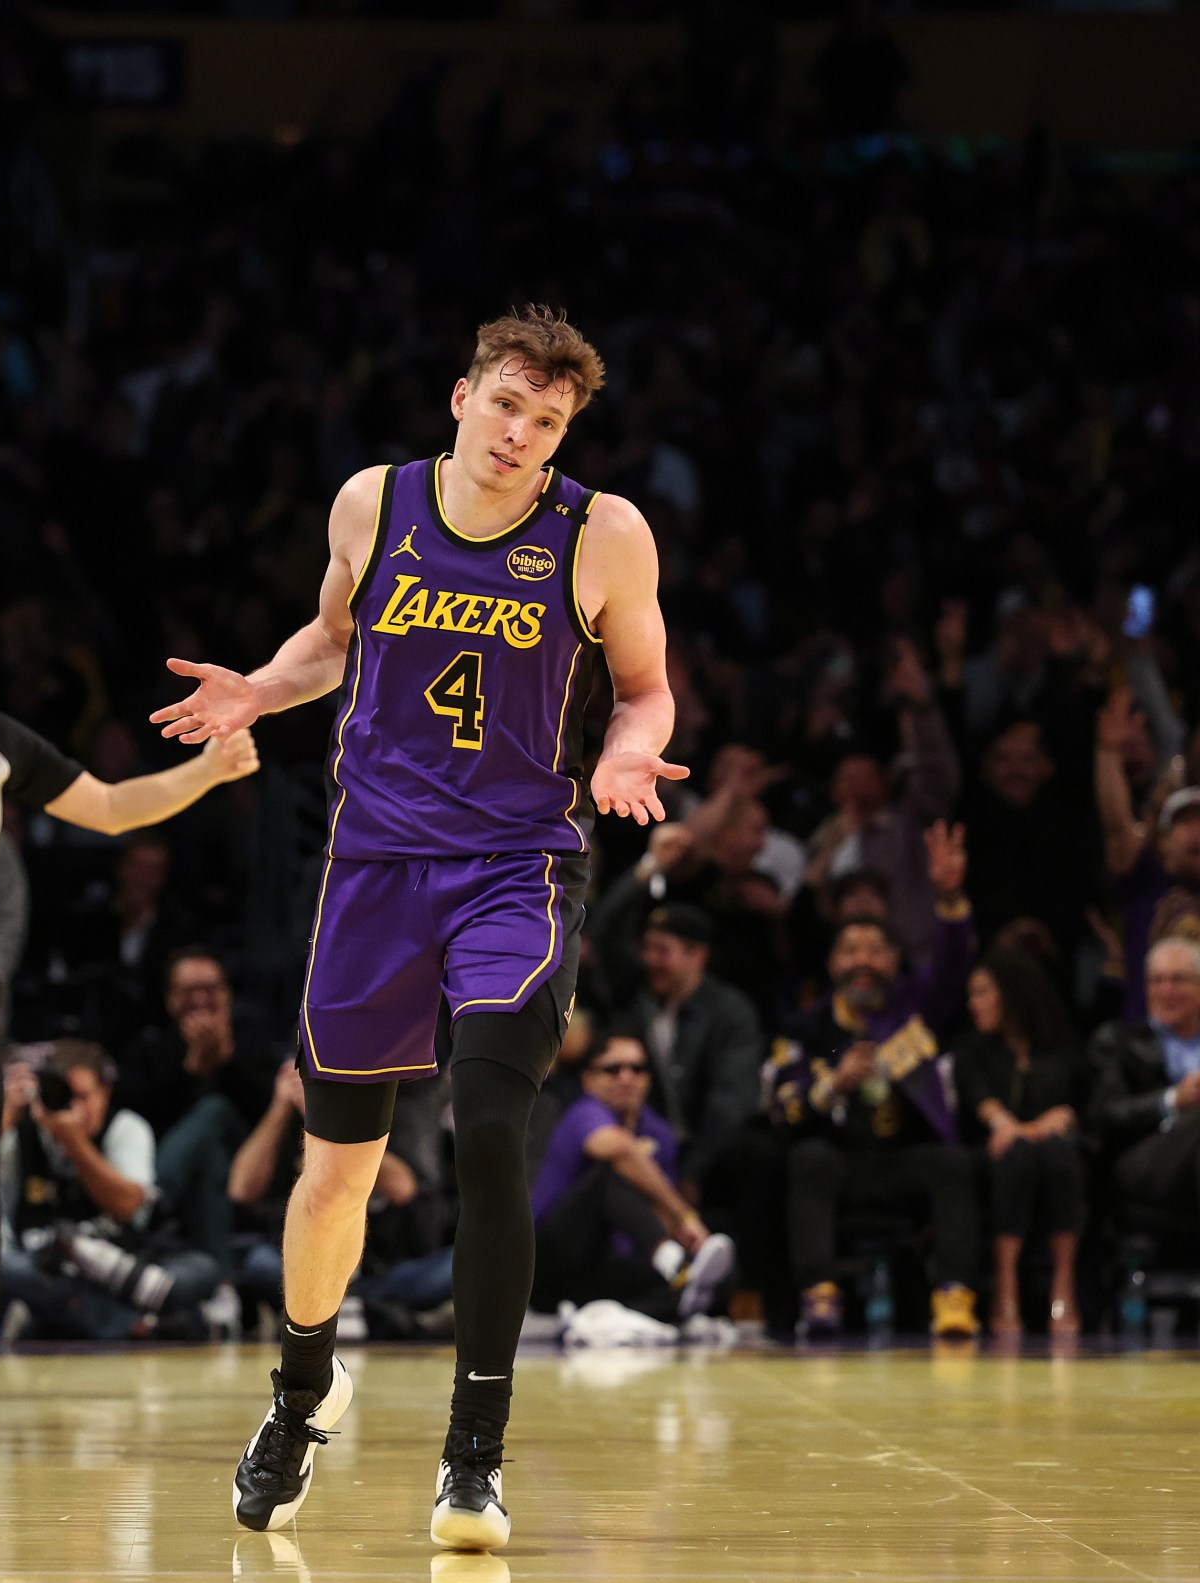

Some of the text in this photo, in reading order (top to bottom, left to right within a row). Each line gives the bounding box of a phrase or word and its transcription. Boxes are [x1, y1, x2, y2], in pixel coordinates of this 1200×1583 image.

[555, 503, 570, 516] 44
[512, 553, 553, 572] bibigo
[370, 573, 547, 649] LAKERS
[423, 650, 485, 751] 4
